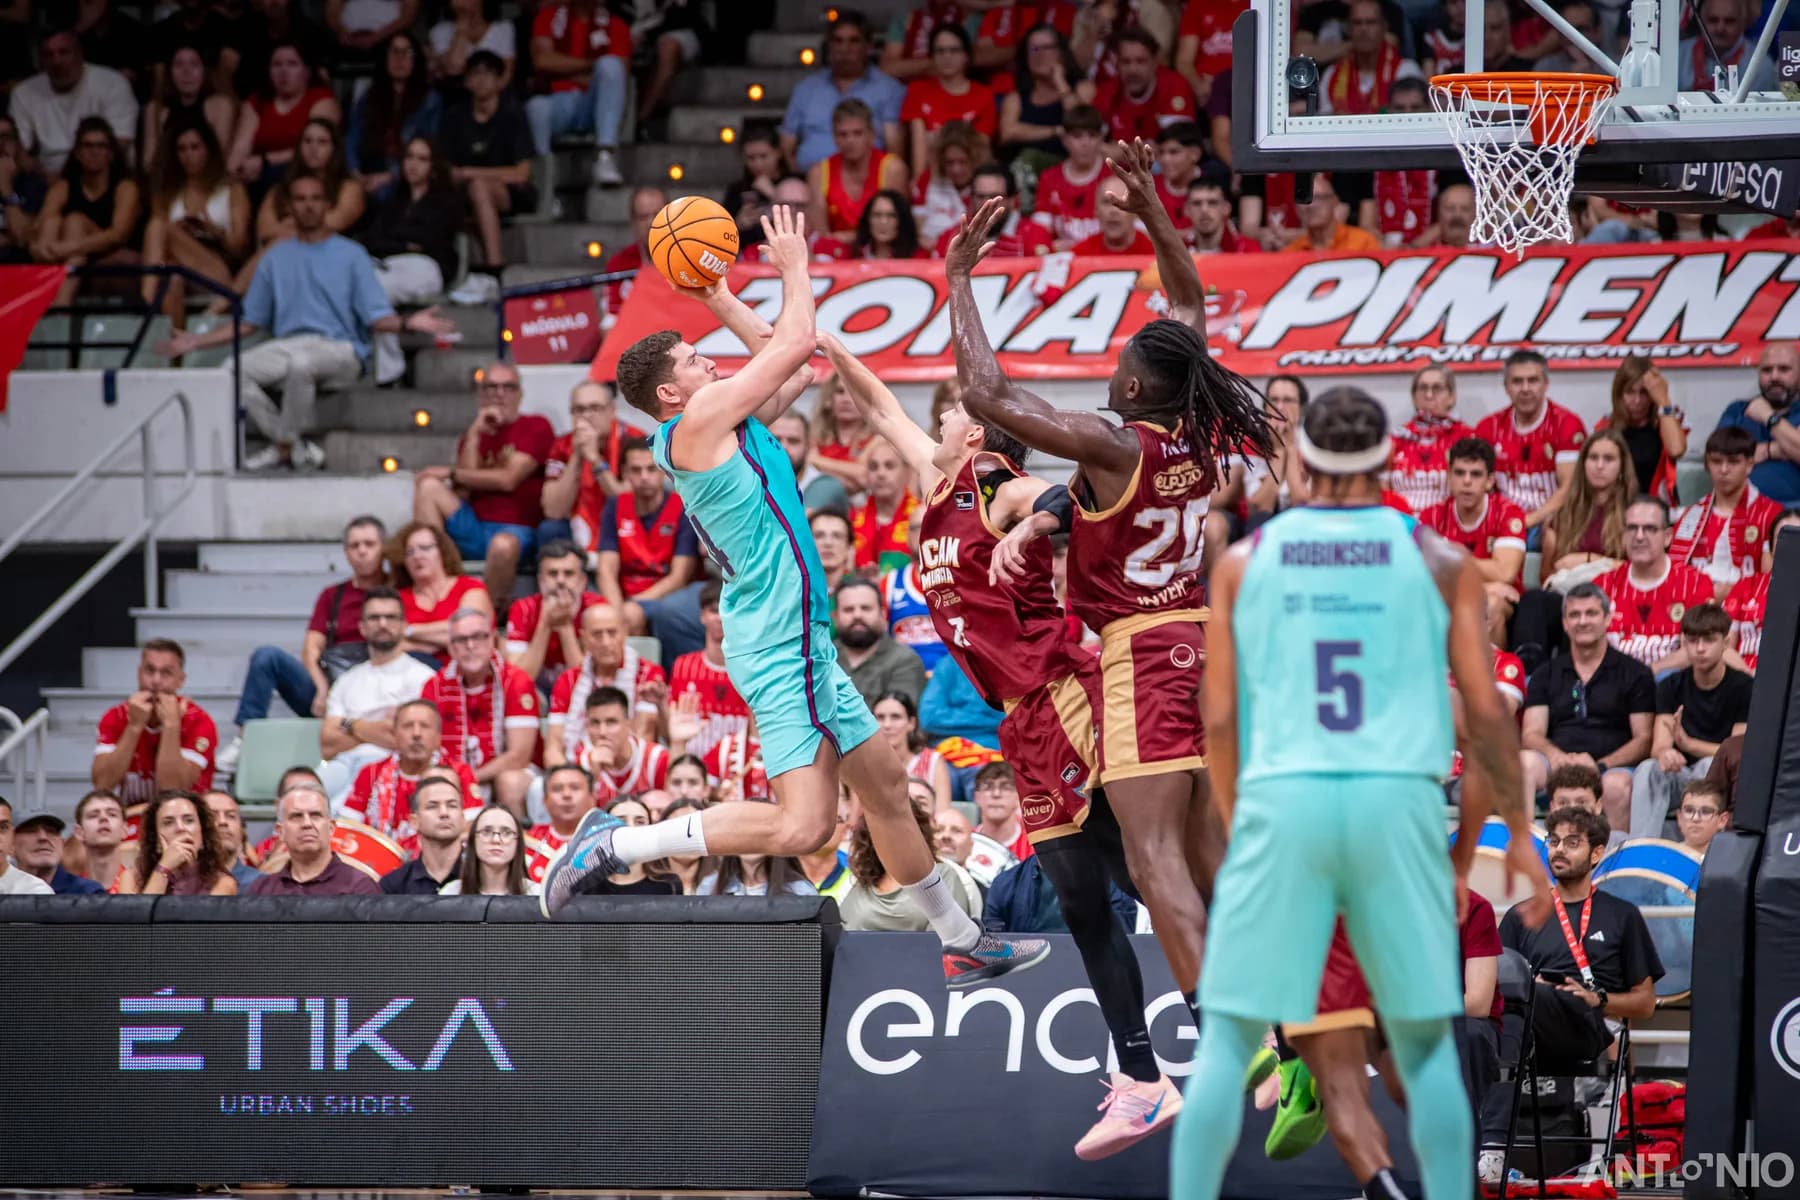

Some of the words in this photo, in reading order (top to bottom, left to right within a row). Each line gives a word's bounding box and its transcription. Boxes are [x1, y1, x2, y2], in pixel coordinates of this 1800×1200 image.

[694, 271, 1140, 356] ZONA
[1123, 497, 1211, 587] 20
[1281, 541, 1391, 567] ROBINSON
[1314, 640, 1364, 733] 5
[846, 987, 1210, 1077] ende
[219, 1095, 312, 1115] URBAN
[322, 1095, 415, 1115] SHOES
